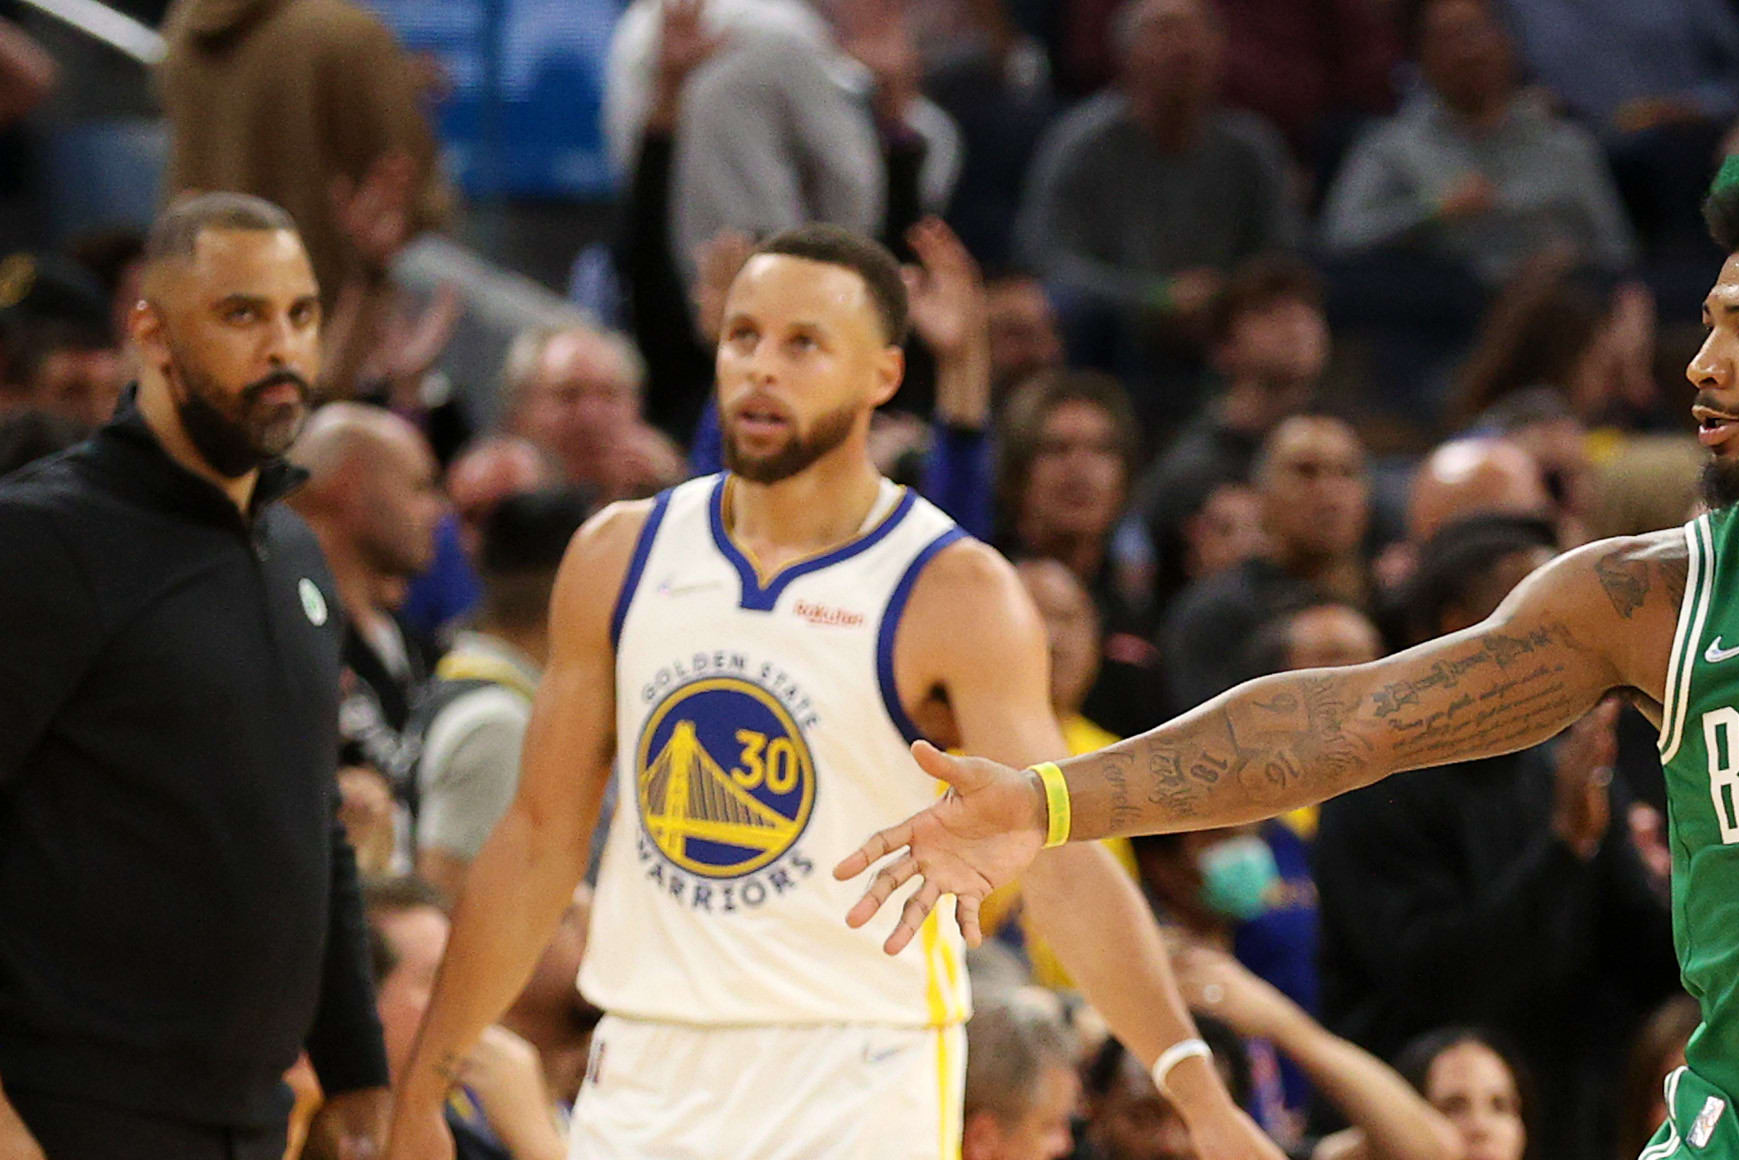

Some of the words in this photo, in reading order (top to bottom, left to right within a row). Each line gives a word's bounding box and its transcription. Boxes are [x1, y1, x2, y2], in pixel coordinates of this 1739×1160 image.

[641, 650, 745, 703] GOLDEN
[760, 660, 820, 727] STATE
[731, 728, 799, 795] 30
[638, 834, 816, 914] WARRIORS
